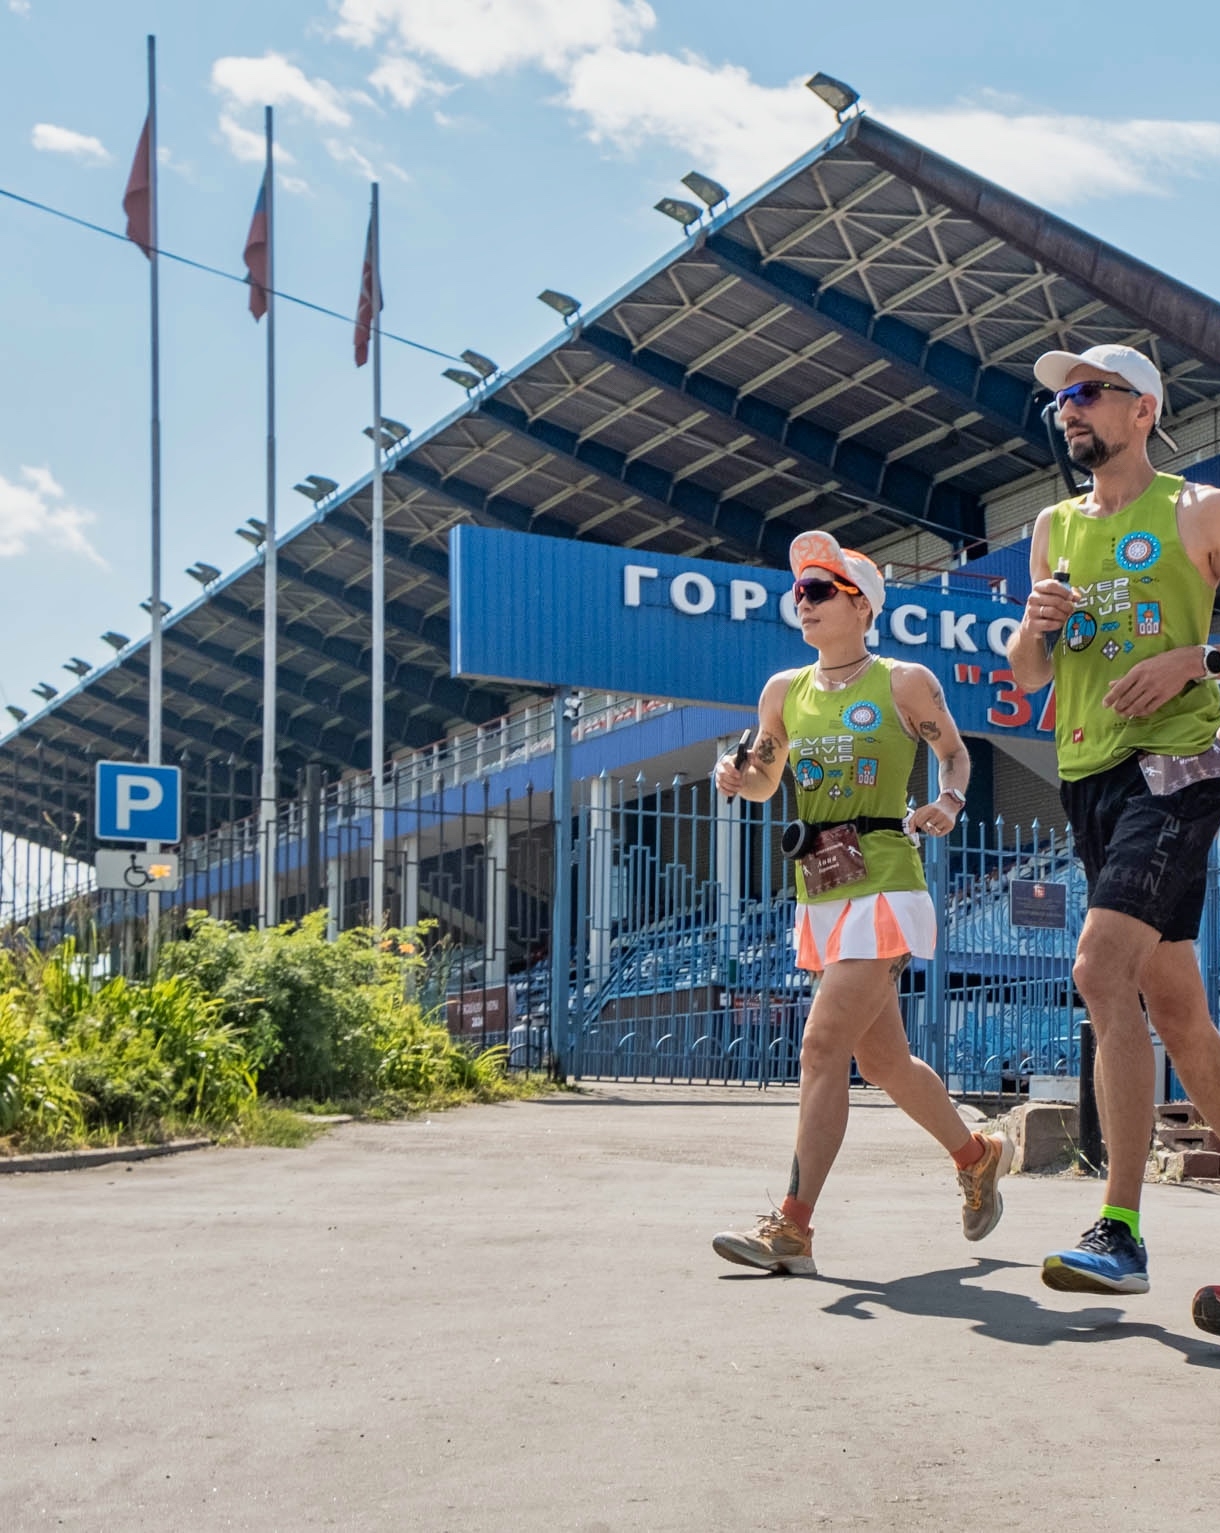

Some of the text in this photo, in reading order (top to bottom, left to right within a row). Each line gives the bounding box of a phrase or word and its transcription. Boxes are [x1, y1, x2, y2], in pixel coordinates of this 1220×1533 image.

[1078, 577, 1129, 592] VER
[1098, 602, 1131, 616] UP
[800, 745, 852, 756] GIVE
[823, 755, 853, 763] UP
[115, 774, 164, 830] P
